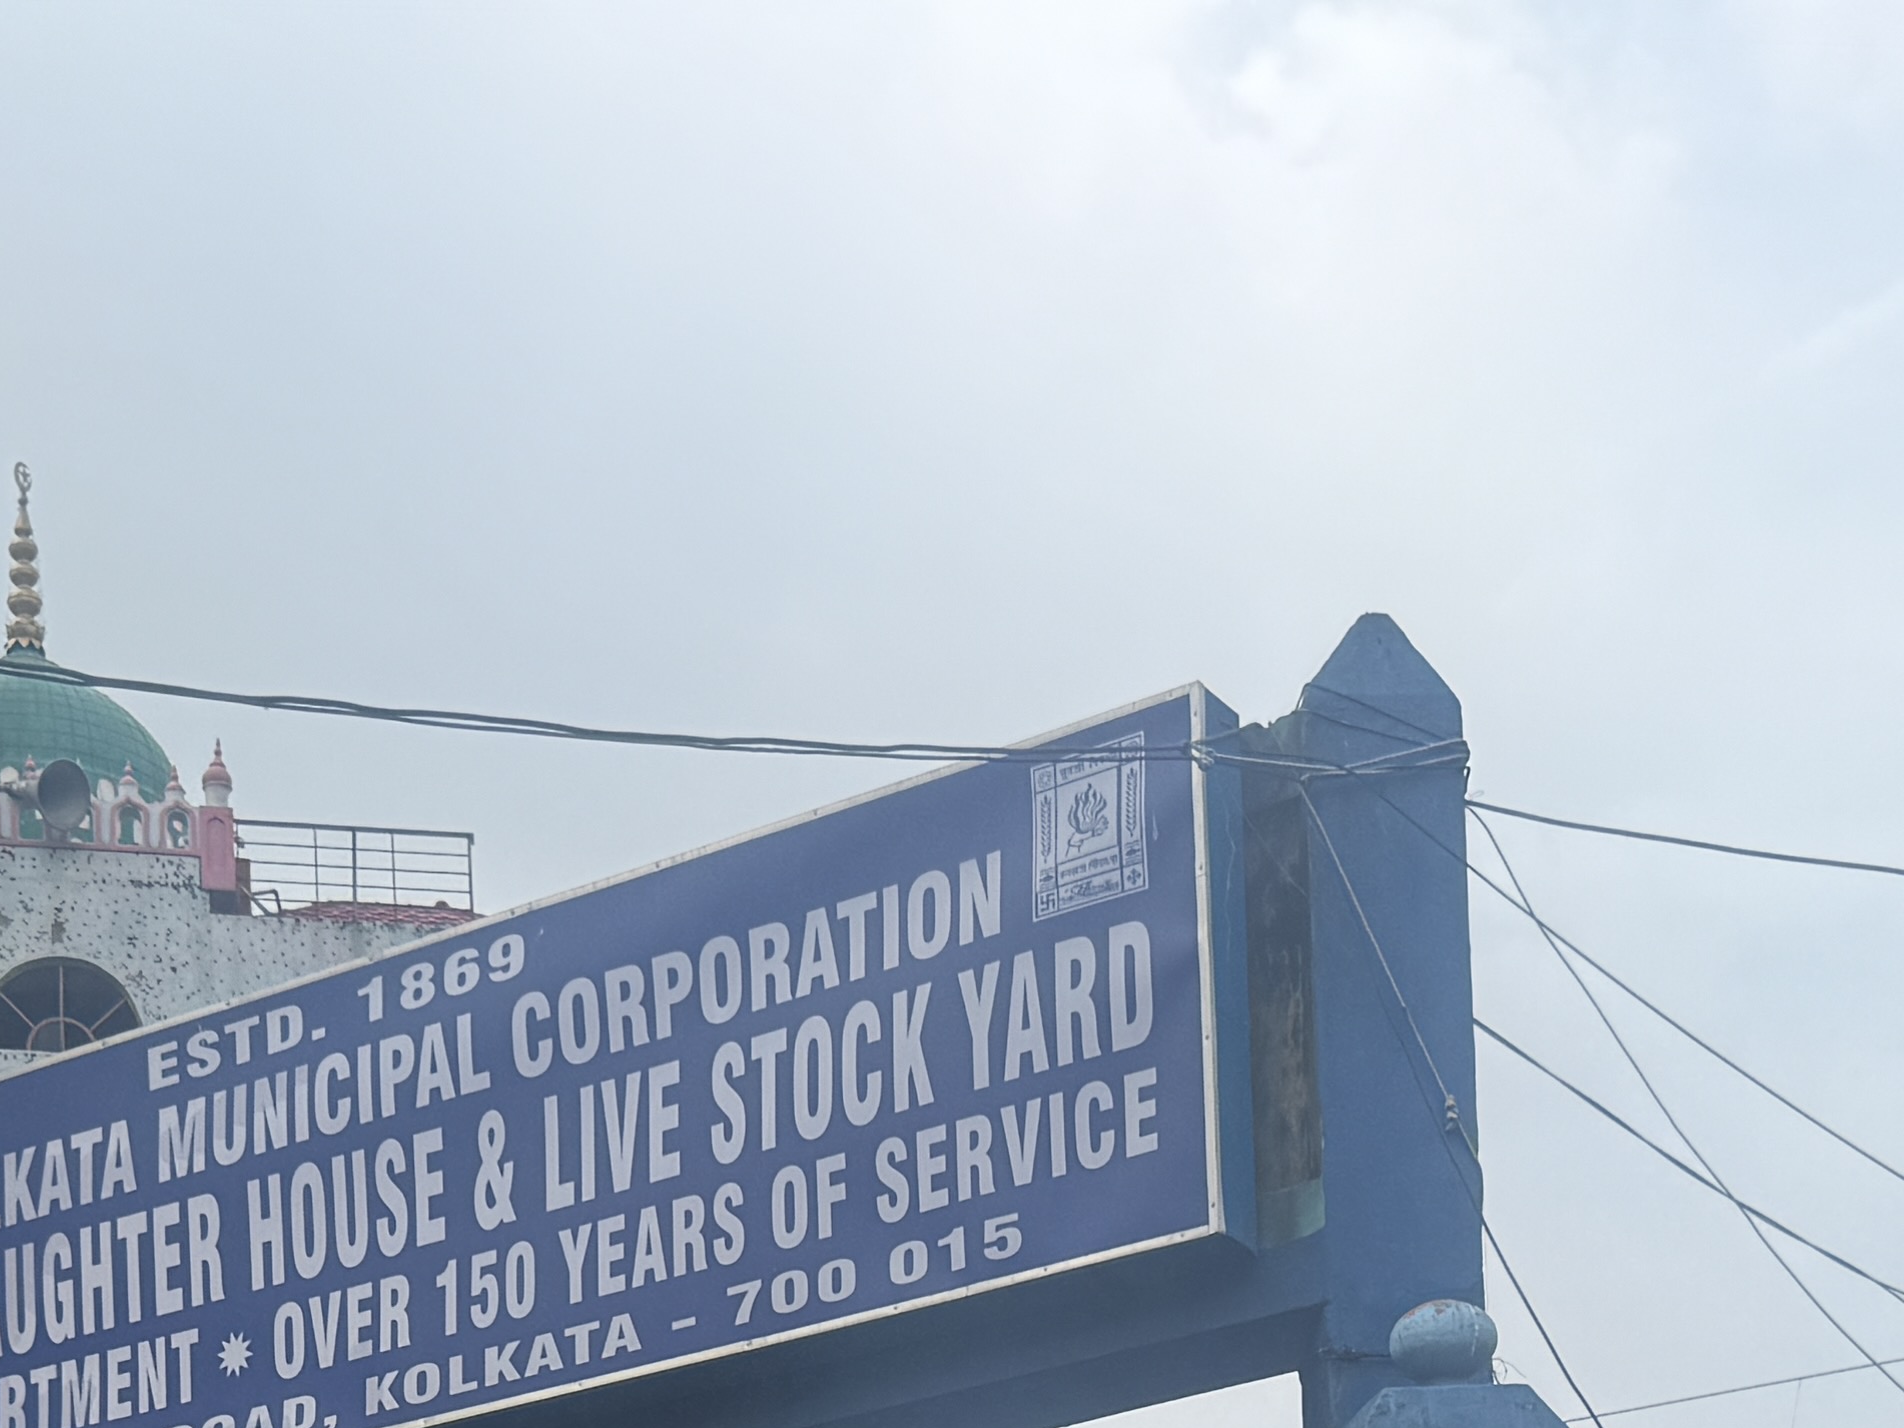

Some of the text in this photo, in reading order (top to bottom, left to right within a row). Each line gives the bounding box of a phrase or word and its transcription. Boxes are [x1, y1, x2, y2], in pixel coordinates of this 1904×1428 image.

[149, 934, 525, 1092] ESTD. 1869
[158, 1012, 491, 1184] MUNICIPAL
[511, 849, 1002, 1078] CORPORATION
[247, 1127, 446, 1292] HOUSE
[473, 1109, 517, 1231] &
[543, 1059, 681, 1212] LIVE
[710, 981, 935, 1165] STOCK
[957, 920, 1153, 1091] YARD
[273, 1274, 411, 1380] OVER
[435, 1240, 536, 1336] 150
[558, 1182, 745, 1305] YEARS
[771, 1152, 847, 1250] OF
[875, 1066, 1159, 1224] SERVICE
[366, 1312, 640, 1411] KOLKATA
[727, 1258, 858, 1326] 700
[889, 1211, 1024, 1285] 015
